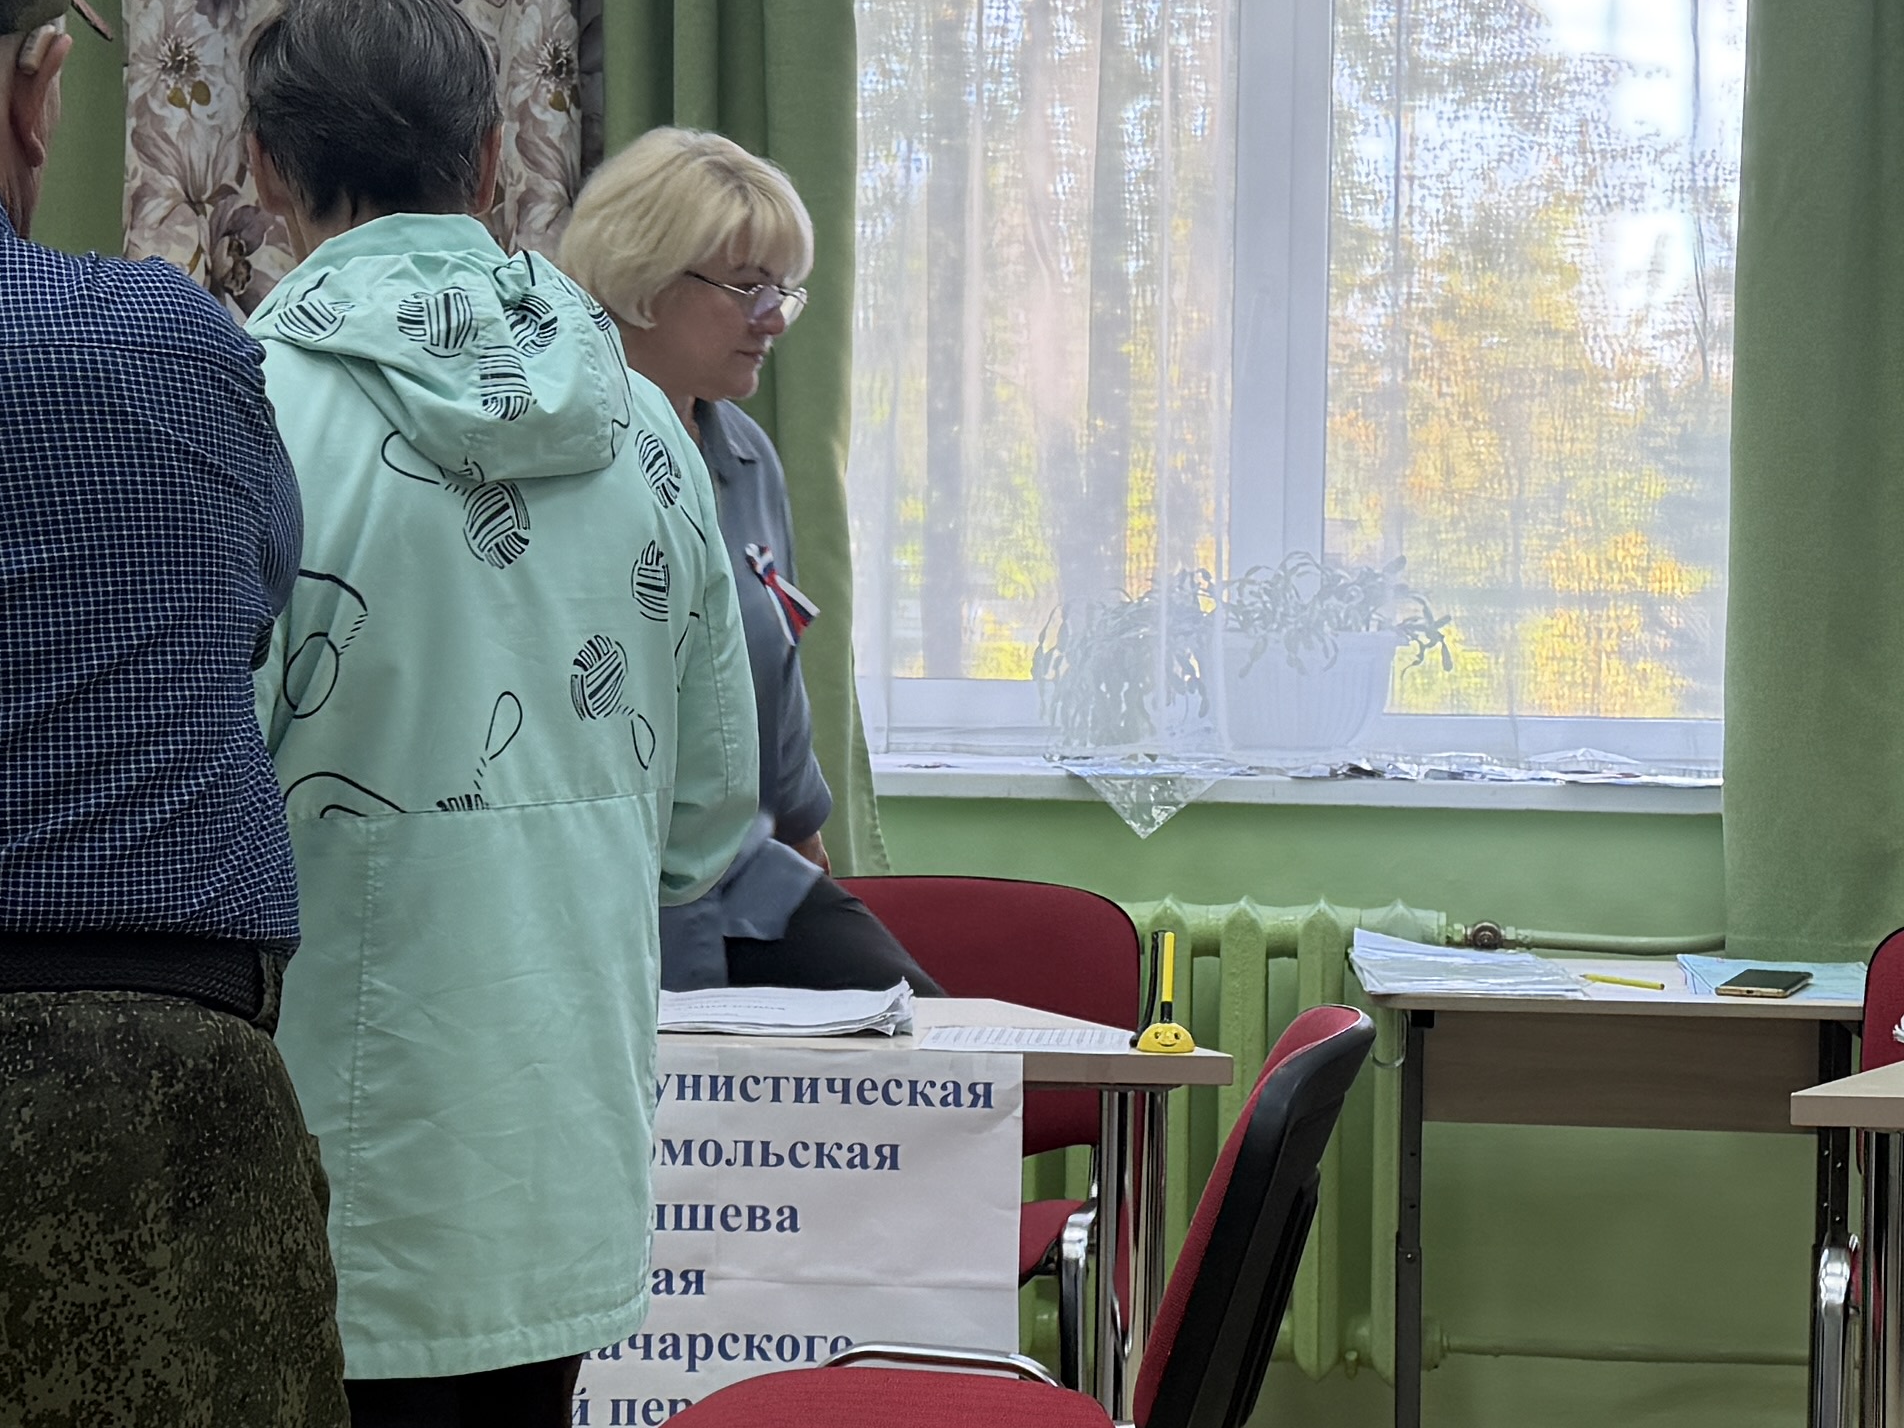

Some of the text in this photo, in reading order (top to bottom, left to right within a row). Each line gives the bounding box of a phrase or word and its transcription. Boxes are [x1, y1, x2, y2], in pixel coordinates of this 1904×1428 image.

[655, 1073, 994, 1110] унистическая
[652, 1137, 901, 1171] мольская
[654, 1202, 801, 1234] шева
[583, 1332, 854, 1372] ачарского
